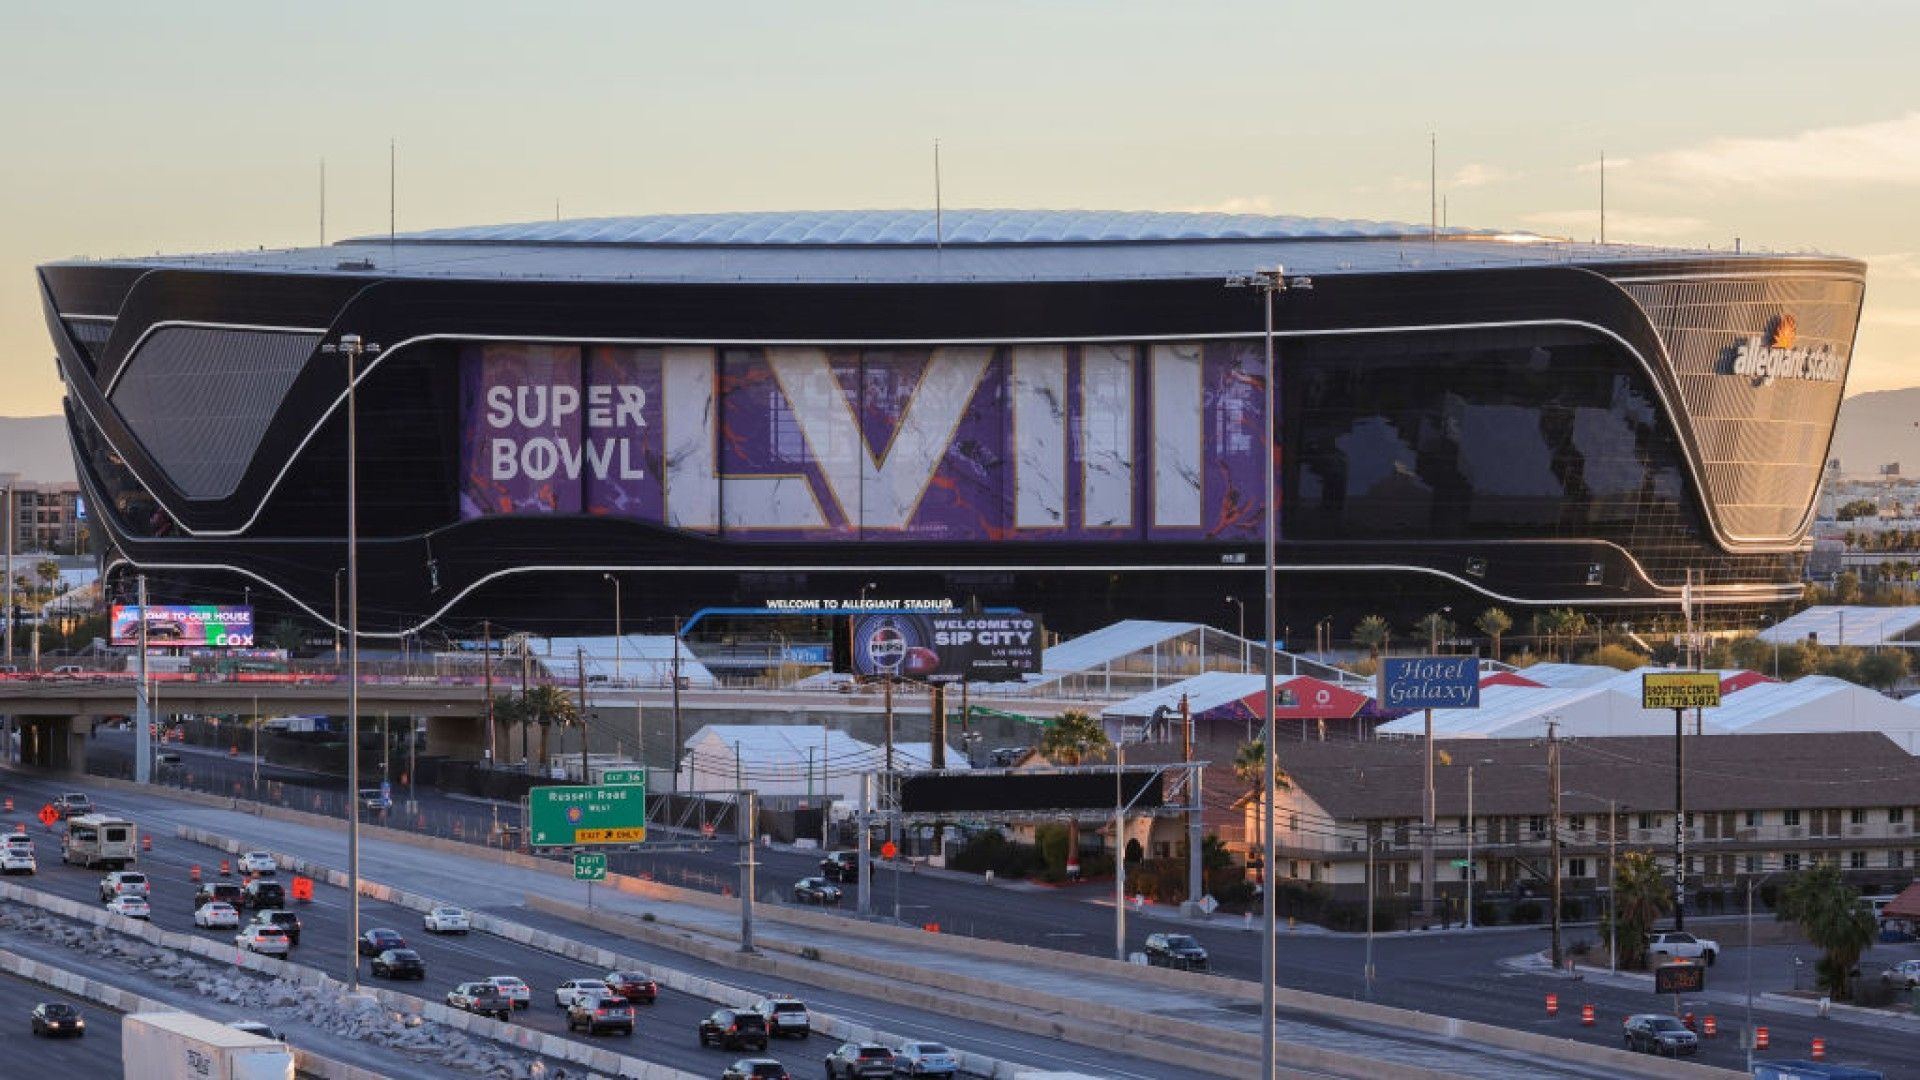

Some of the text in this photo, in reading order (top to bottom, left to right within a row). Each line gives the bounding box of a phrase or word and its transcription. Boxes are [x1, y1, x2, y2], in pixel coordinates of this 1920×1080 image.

[1734, 336, 1807, 385] allegiant
[486, 385, 647, 429] SUPER
[662, 343, 1203, 530] LVIII
[491, 437, 645, 481] BOWL
[766, 599, 954, 610] WELCOME TO ALLEGIANT STADIUM
[117, 611, 251, 621] WELOME TO OUR HOUSE
[934, 619, 1033, 630] WELCOME TO
[216, 633, 253, 646] COX
[934, 631, 1032, 646] SIP CITY
[871, 644, 903, 653] PEPSI
[1398, 660, 1465, 681] Hotel
[1390, 681, 1473, 706] Galaxy
[606, 773, 623, 781] EXIT
[548, 790, 627, 802] Russell Road
[579, 831, 640, 841] EXIT ONLY
[580, 856, 600, 864] EXIT
[576, 866, 592, 875] 36
